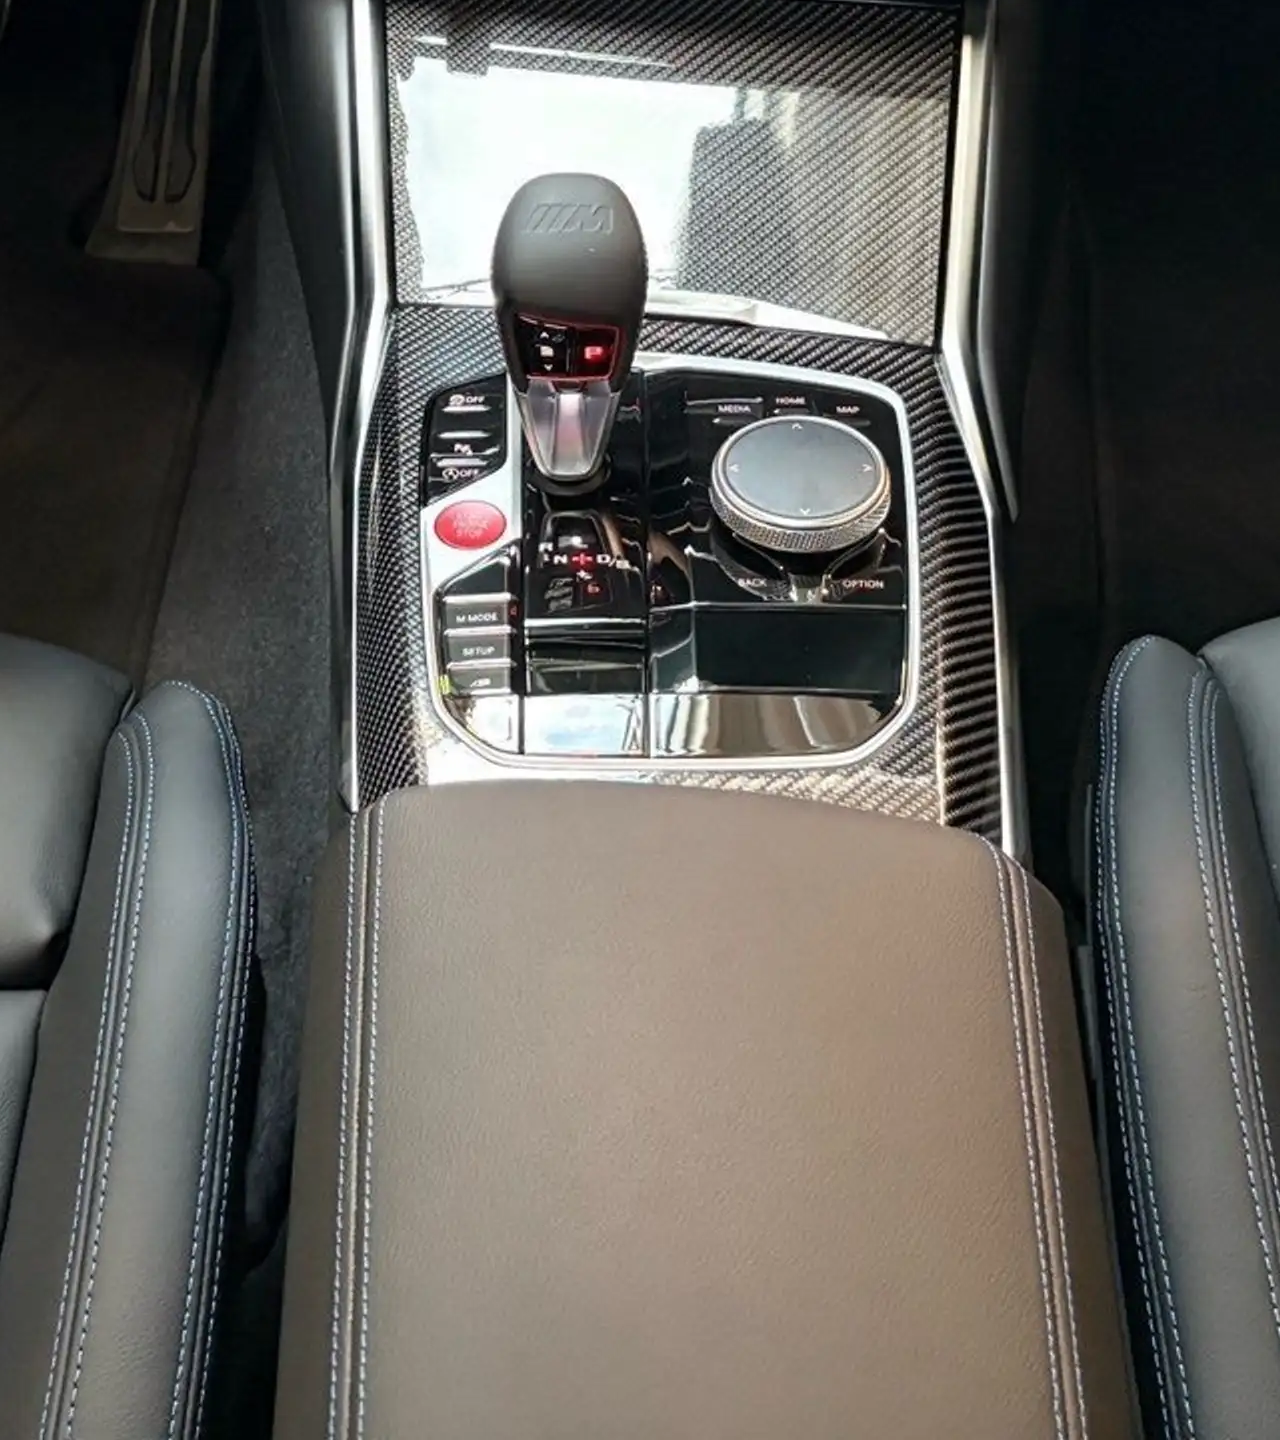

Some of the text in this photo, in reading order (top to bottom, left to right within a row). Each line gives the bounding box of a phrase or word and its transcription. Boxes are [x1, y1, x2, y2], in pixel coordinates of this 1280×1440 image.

[584, 345, 604, 360] P
[465, 395, 486, 404] OFF
[775, 396, 806, 405] HOME
[718, 404, 751, 413] MEDIA
[836, 406, 860, 414] MAP
[553, 554, 568, 565] N
[738, 579, 767, 587] BACK
[842, 580, 885, 589] OPTION
[468, 613, 497, 622] MODE
